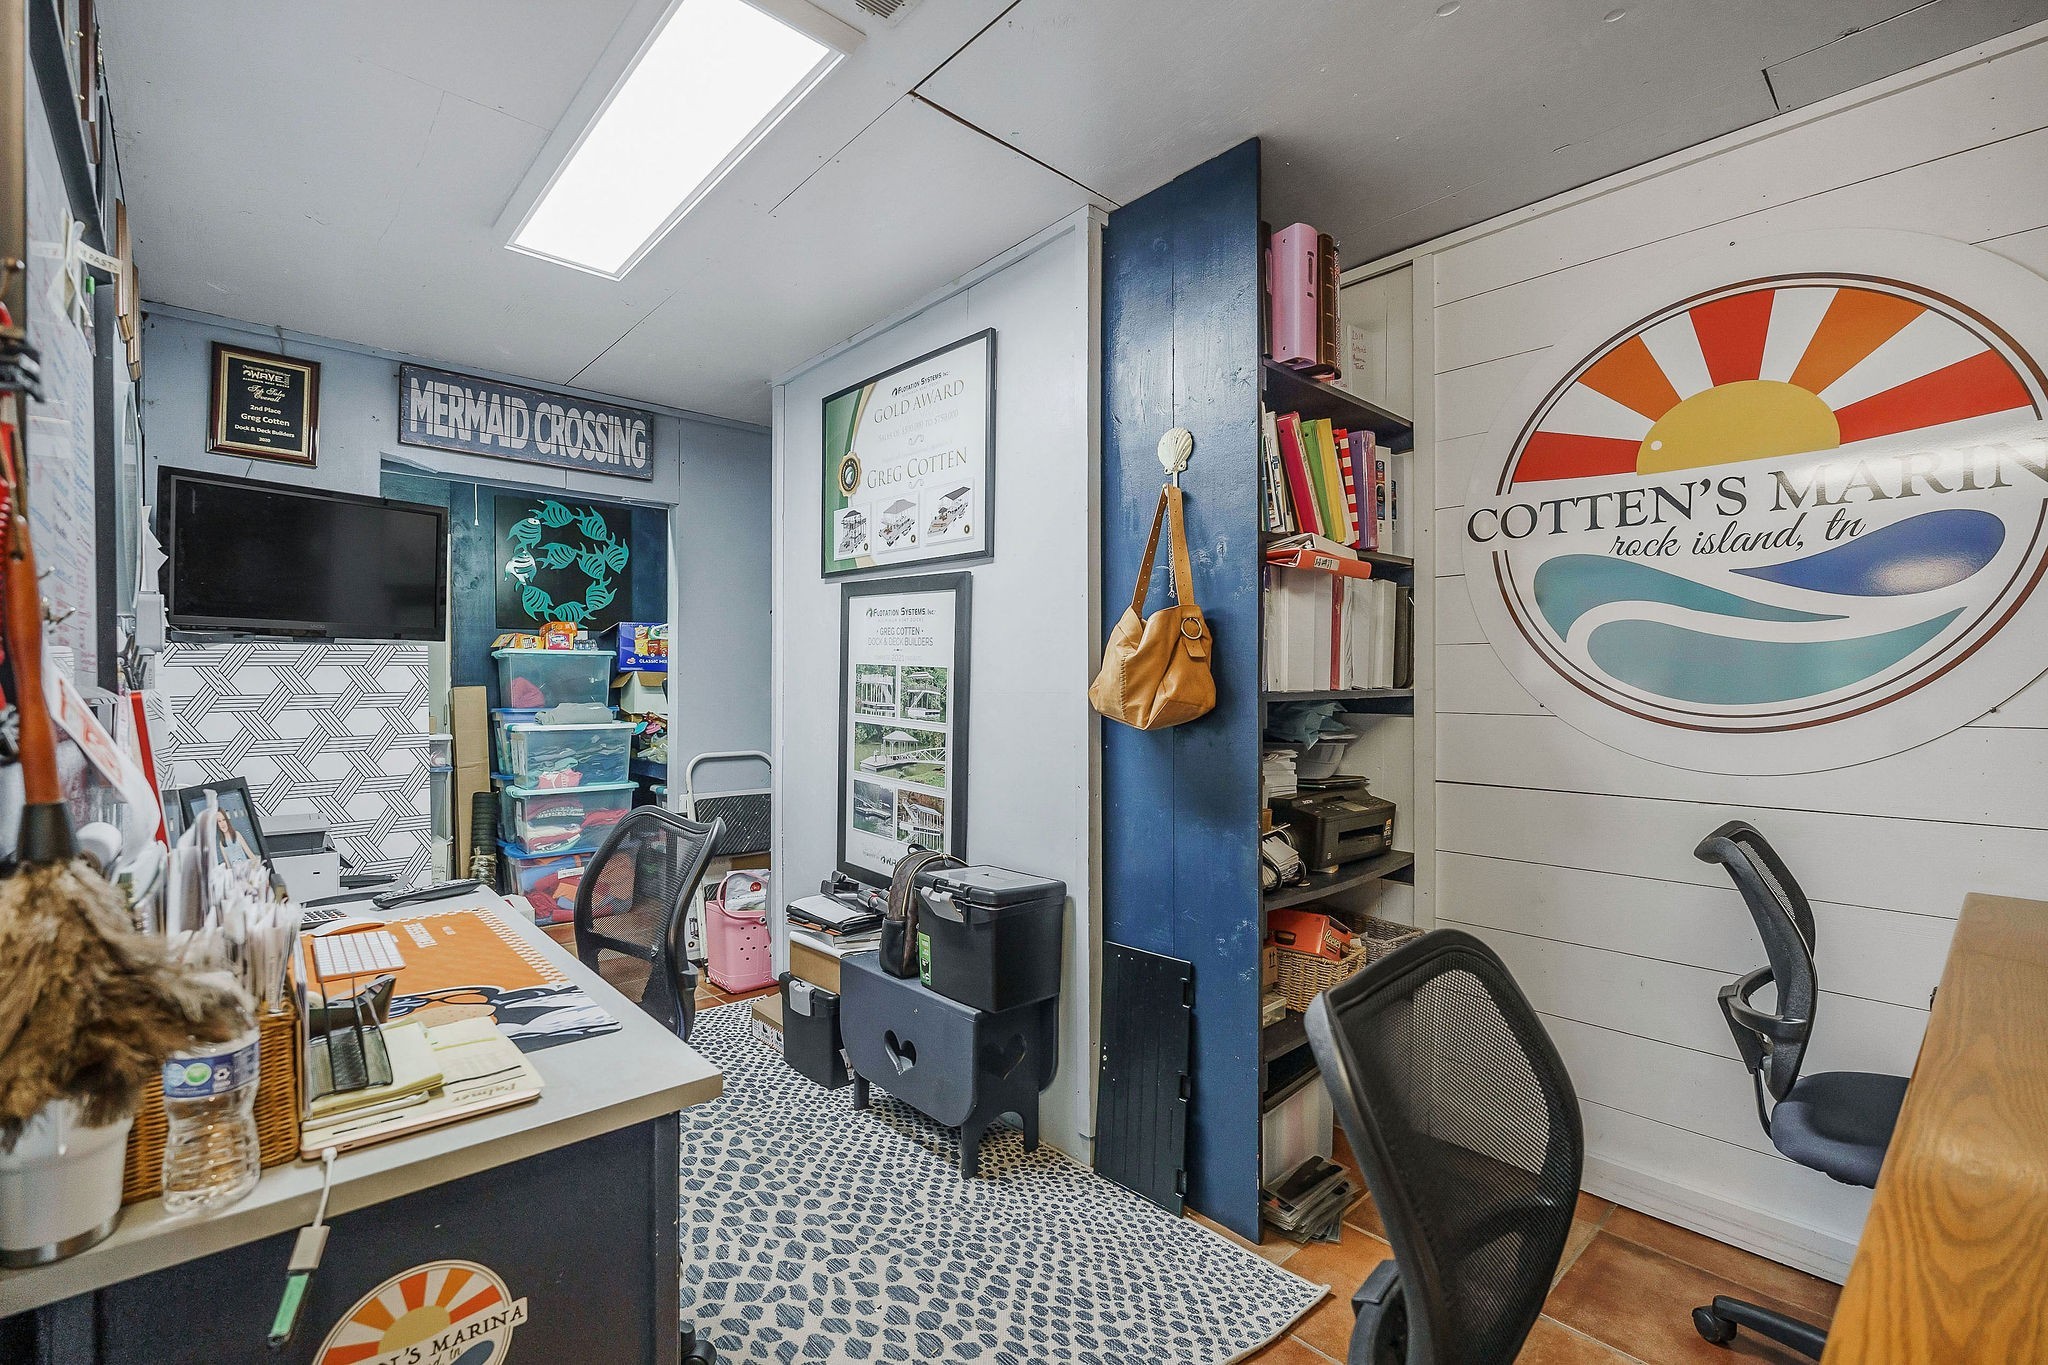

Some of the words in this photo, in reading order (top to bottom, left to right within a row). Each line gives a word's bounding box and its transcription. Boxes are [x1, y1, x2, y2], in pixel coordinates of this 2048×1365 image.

[241, 413, 261, 423] Greg
[263, 417, 290, 427] Cotten
[410, 377, 529, 450] MERMAID
[533, 402, 648, 470] CROSSING
[874, 399, 910, 424] GOLD
[912, 379, 965, 411] AWARD
[867, 465, 902, 489] GREG
[907, 446, 968, 479] COTTEN
[1467, 476, 1747, 543] COTTEN'S
[1609, 527, 1680, 556] rock
[1692, 512, 1805, 554] island,
[1825, 507, 1866, 540] tn
[880, 627, 895, 635] GREG
[896, 626, 920, 636] COTTEN
[900, 607, 926, 616] SYSTEMS
[904, 637, 934, 646] BUILDERS
[430, 1305, 523, 1356] MARINA
